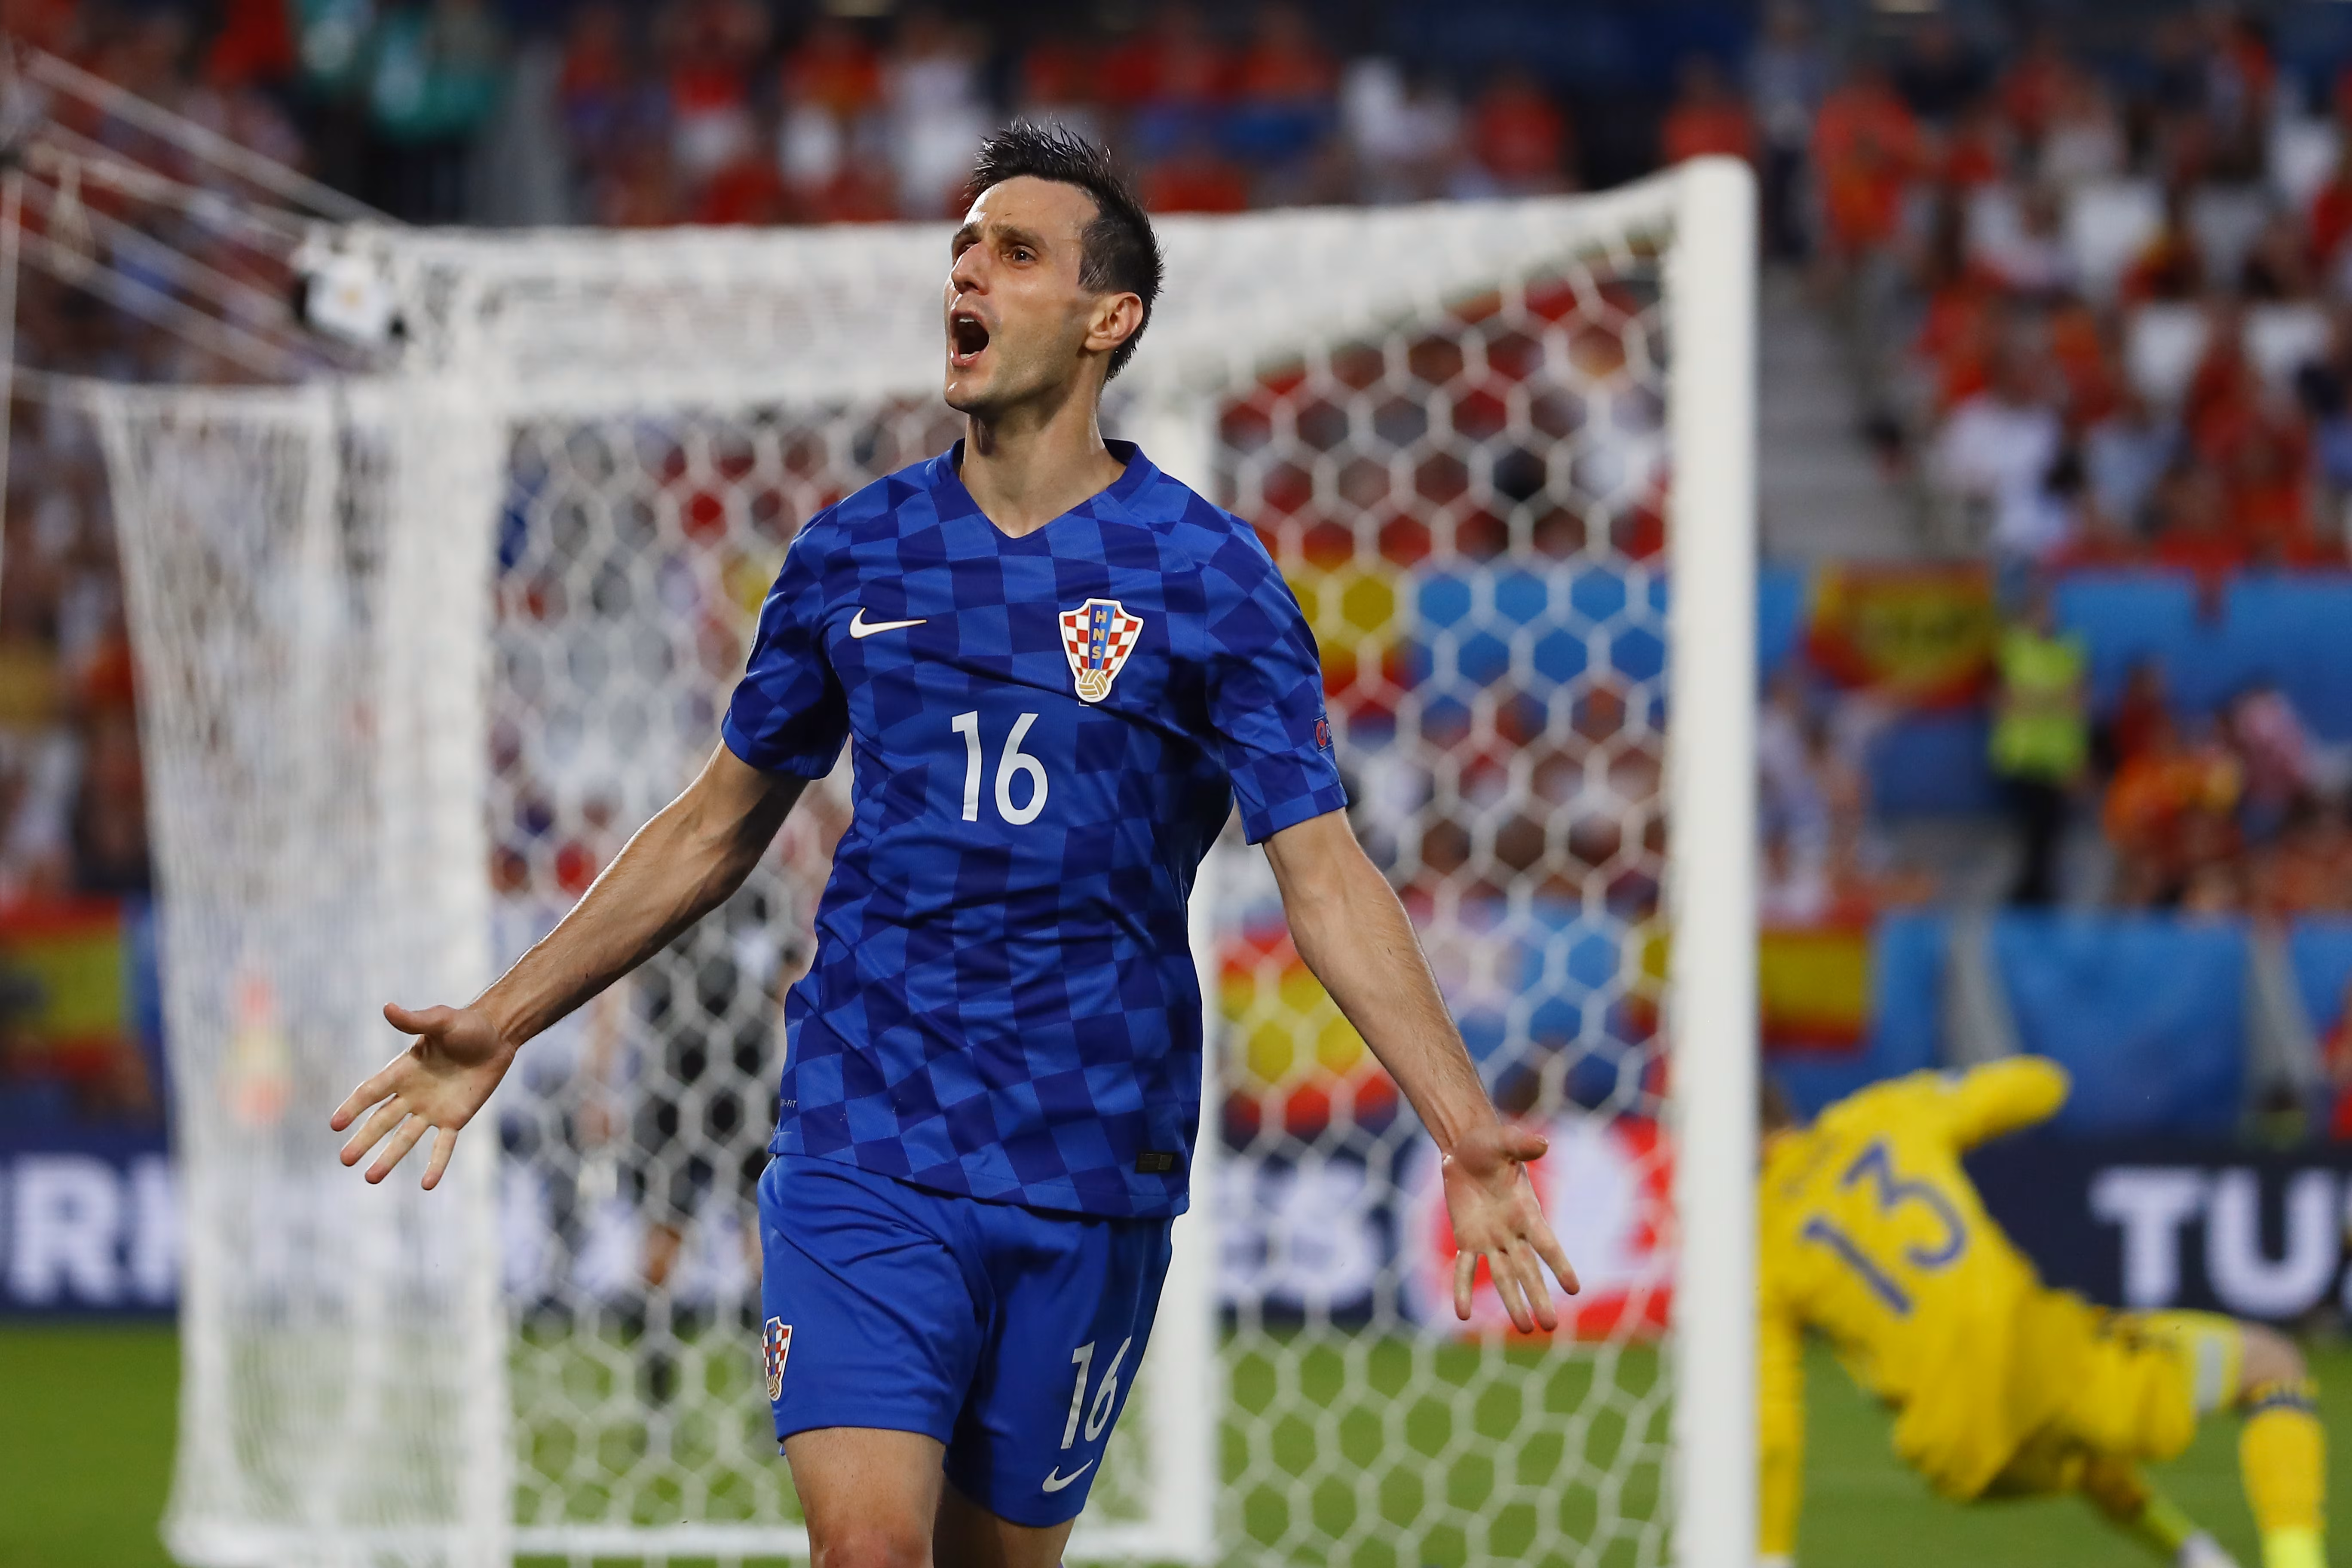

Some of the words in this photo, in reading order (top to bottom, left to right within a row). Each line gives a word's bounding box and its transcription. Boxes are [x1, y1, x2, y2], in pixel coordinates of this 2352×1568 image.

[1091, 610, 1108, 659] HNS
[952, 710, 1048, 825] 16
[1804, 1141, 1968, 1316] 13
[2087, 1166, 2352, 1317] TU
[1060, 1335, 1132, 1449] 16
